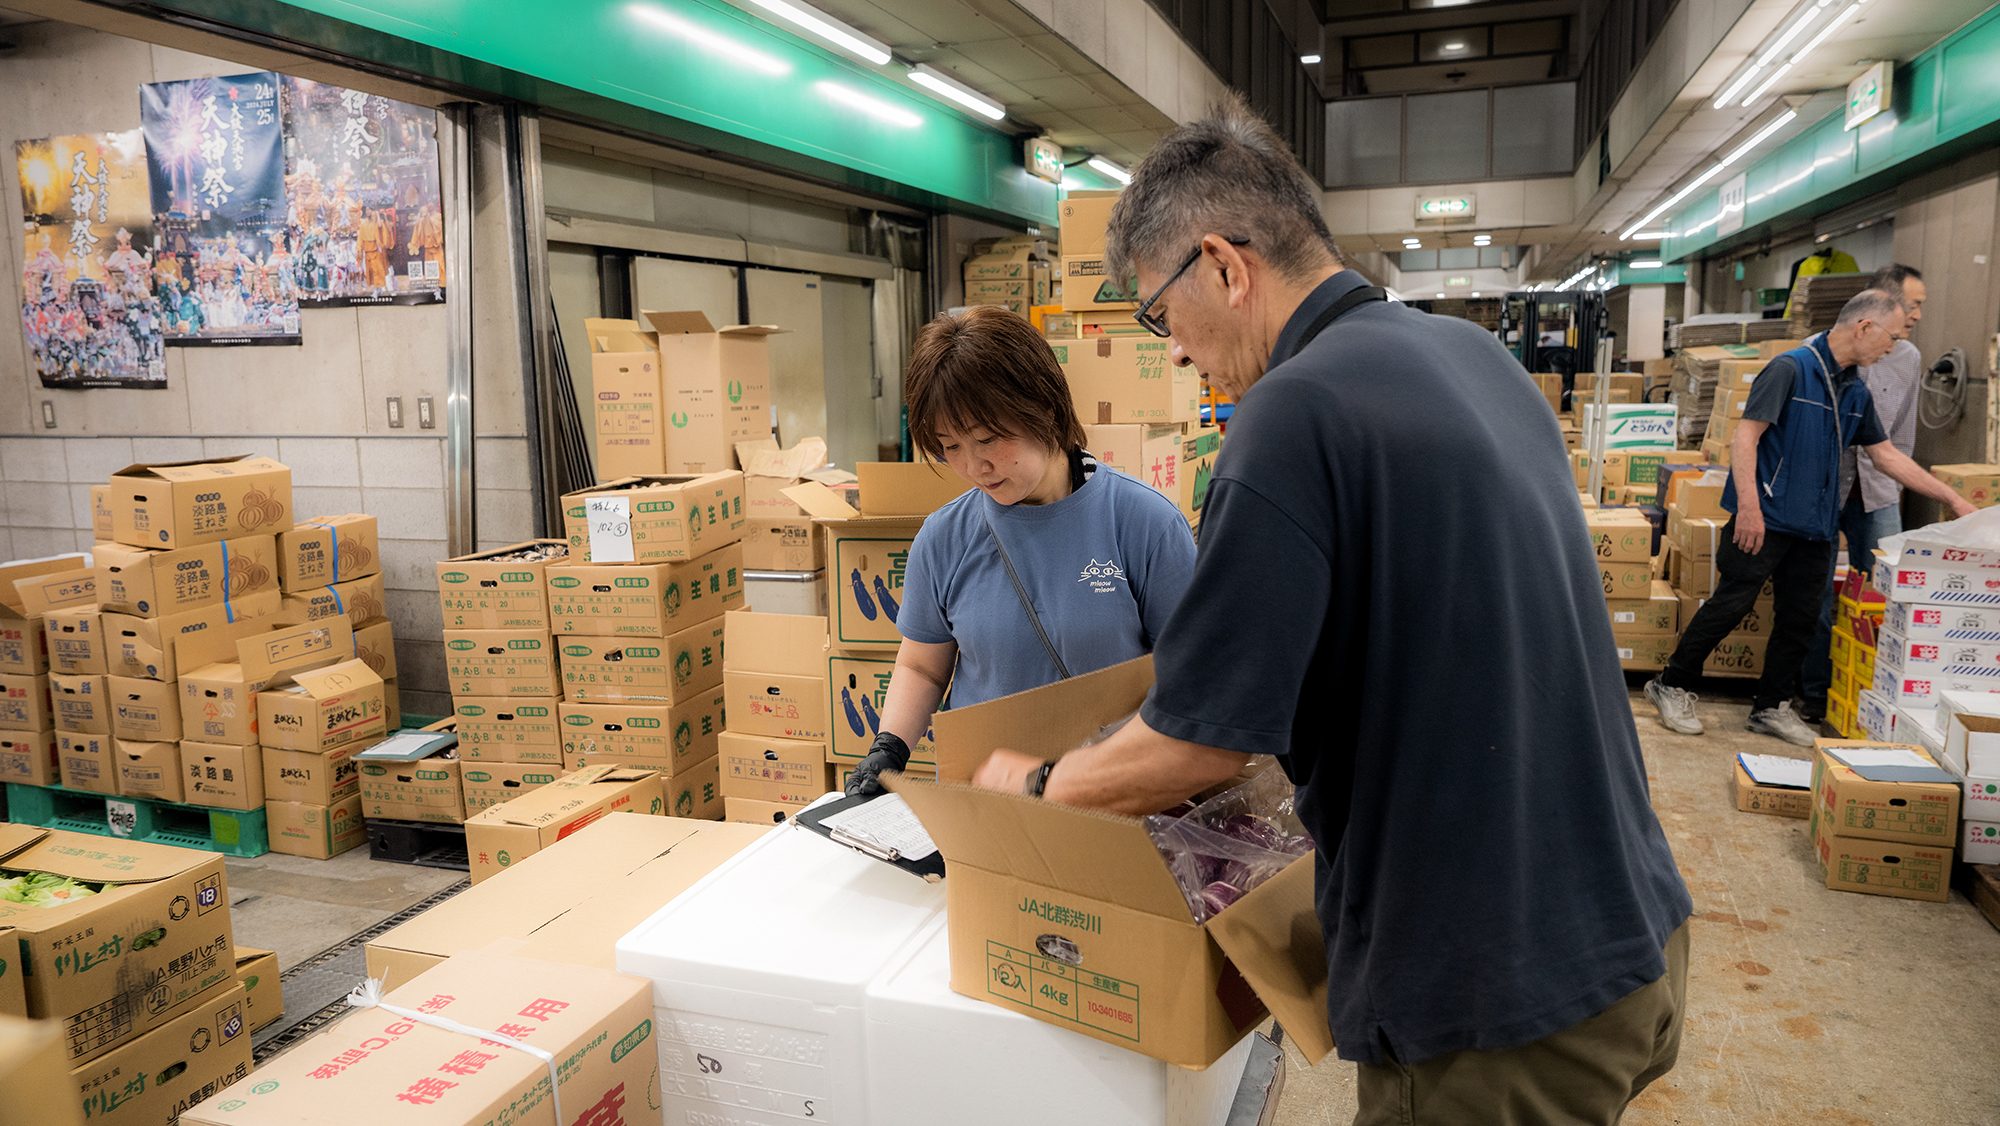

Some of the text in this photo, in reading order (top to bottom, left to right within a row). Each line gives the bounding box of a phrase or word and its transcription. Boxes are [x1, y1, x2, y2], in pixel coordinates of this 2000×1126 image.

[200, 95, 235, 208] 天神祭
[69, 151, 100, 259] 天神祭
[1136, 354, 1167, 367] カット
[1138, 367, 1164, 379] 舞茸
[1631, 424, 1670, 435] とうがん
[1151, 455, 1175, 488] 大葉
[193, 502, 227, 517] 淡路島
[193, 516, 228, 530] 玉ねぎ
[174, 569, 210, 585] 淡路島
[691, 567, 737, 600] 生椎茸
[176, 582, 211, 599] 玉ねぎ
[190, 764, 234, 782] 淡路島
[200, 888, 215, 904] 18
[1018, 896, 1101, 935] JA北群渋川
[52, 927, 94, 950] 野菜王国
[54, 934, 125, 977] 川上村
[1005, 949, 1012, 959] A
[1092, 975, 1121, 994] 生産者
[1039, 983, 1069, 1006] 4kg
[224, 1016, 242, 1036] 18
[613, 1022, 650, 1060] 愛知県産
[80, 1066, 121, 1093] 野菜王国
[82, 1071, 149, 1120] 川上村
[804, 1099, 815, 1117] S
